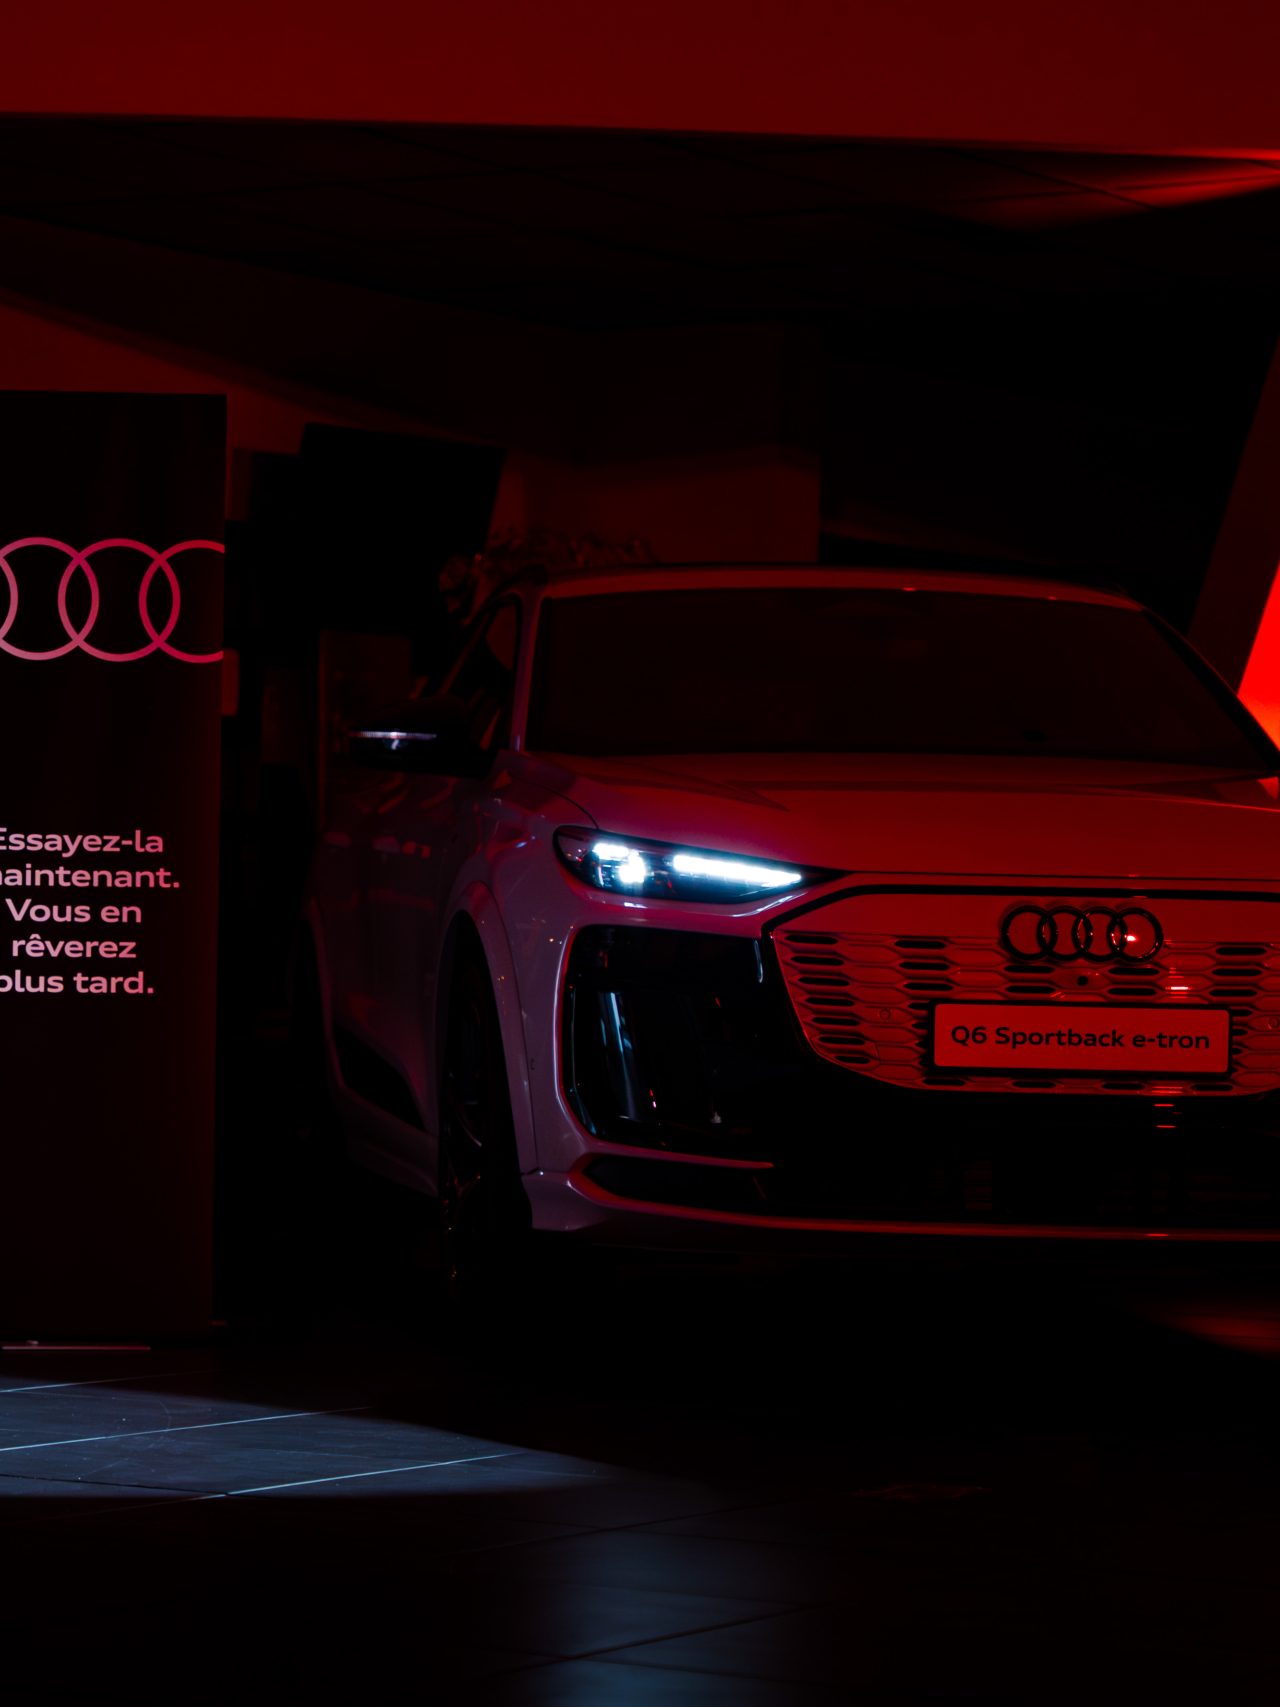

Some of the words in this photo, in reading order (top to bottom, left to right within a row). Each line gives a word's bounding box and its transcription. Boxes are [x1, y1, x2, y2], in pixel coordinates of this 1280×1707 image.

[5, 898, 91, 922] Vous
[100, 905, 142, 923] en
[12, 934, 137, 958] rêverez
[73, 971, 154, 994] tard.
[951, 1026, 988, 1046] Q6
[994, 1026, 1126, 1049] Sportback
[1132, 1031, 1211, 1049] e-tron
